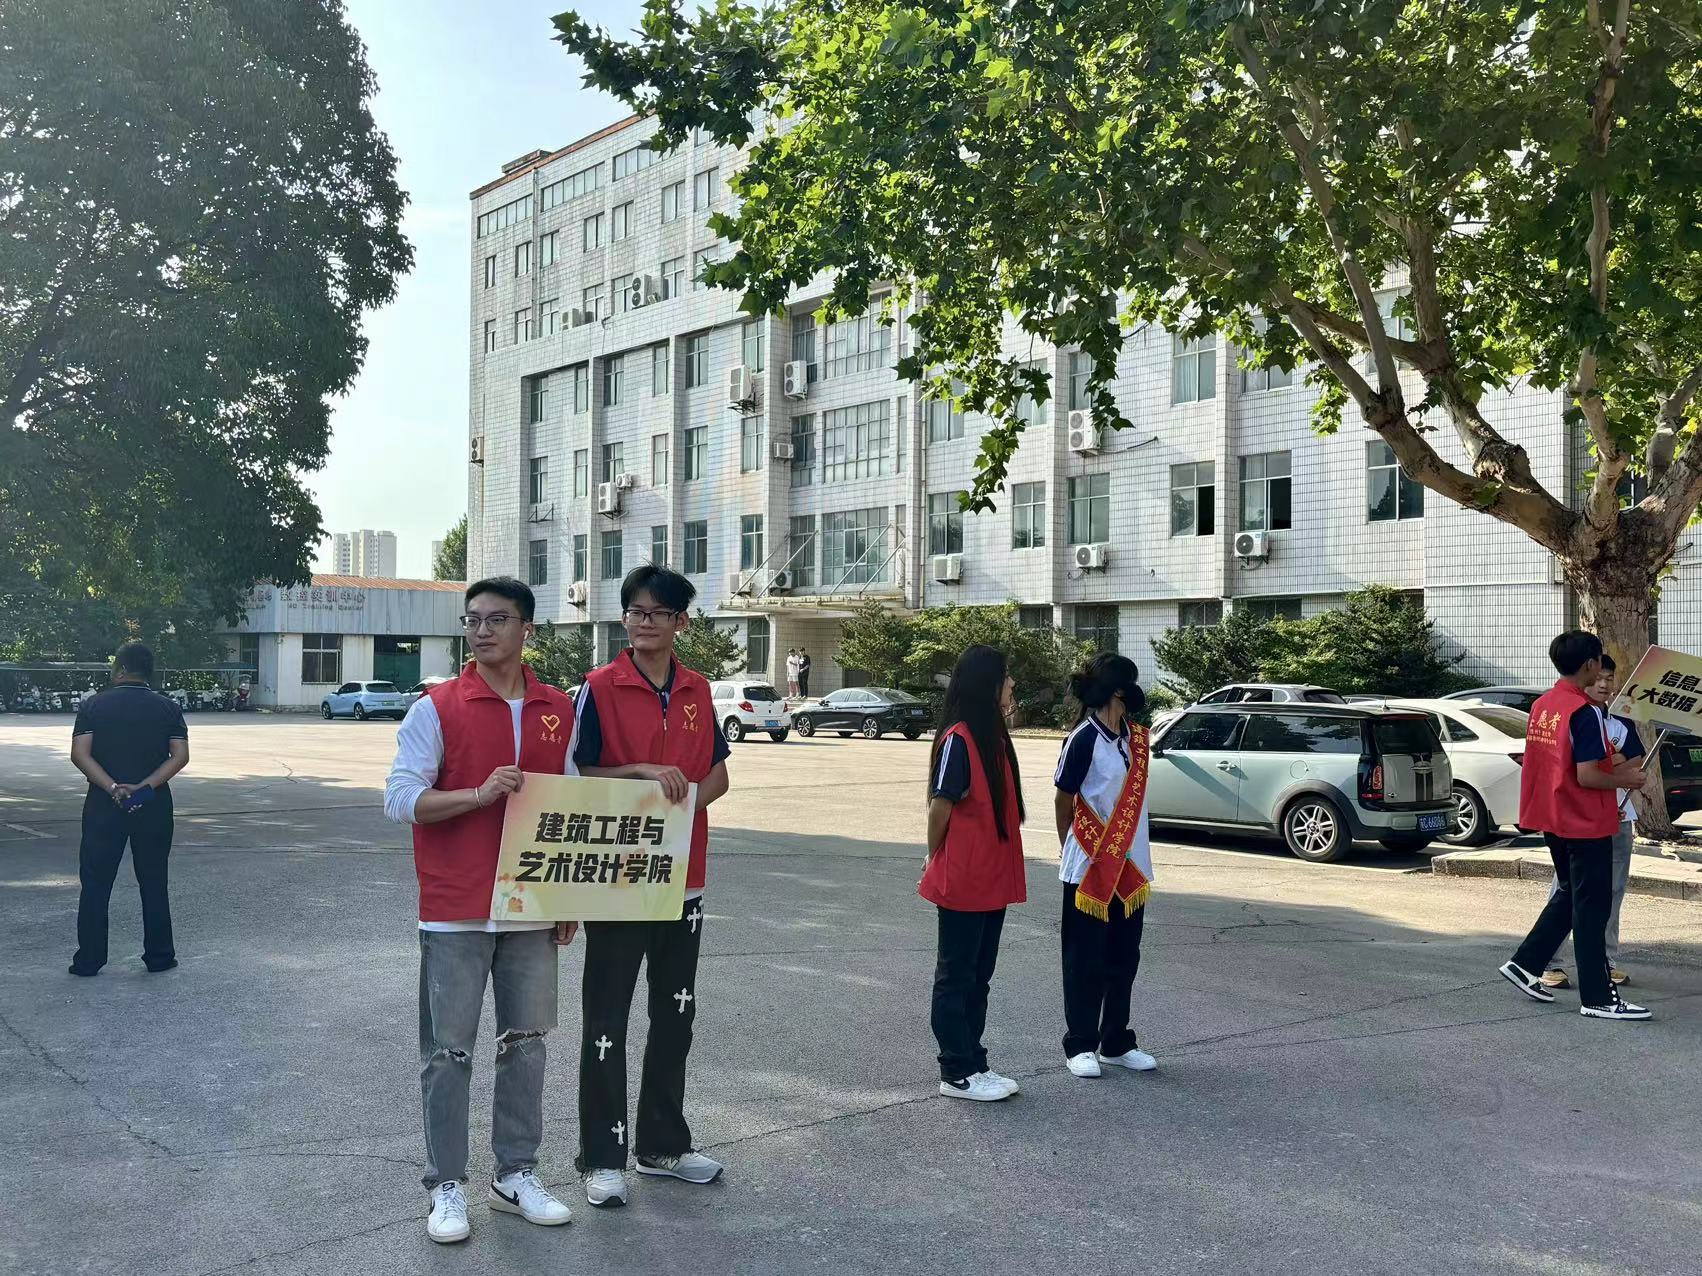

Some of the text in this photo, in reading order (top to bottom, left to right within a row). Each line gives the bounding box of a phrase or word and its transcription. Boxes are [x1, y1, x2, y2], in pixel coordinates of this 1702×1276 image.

[1658, 669, 1702, 695] 信息
[534, 811, 665, 846] 建筑工程与
[515, 850, 673, 884] 艺术设计学院
